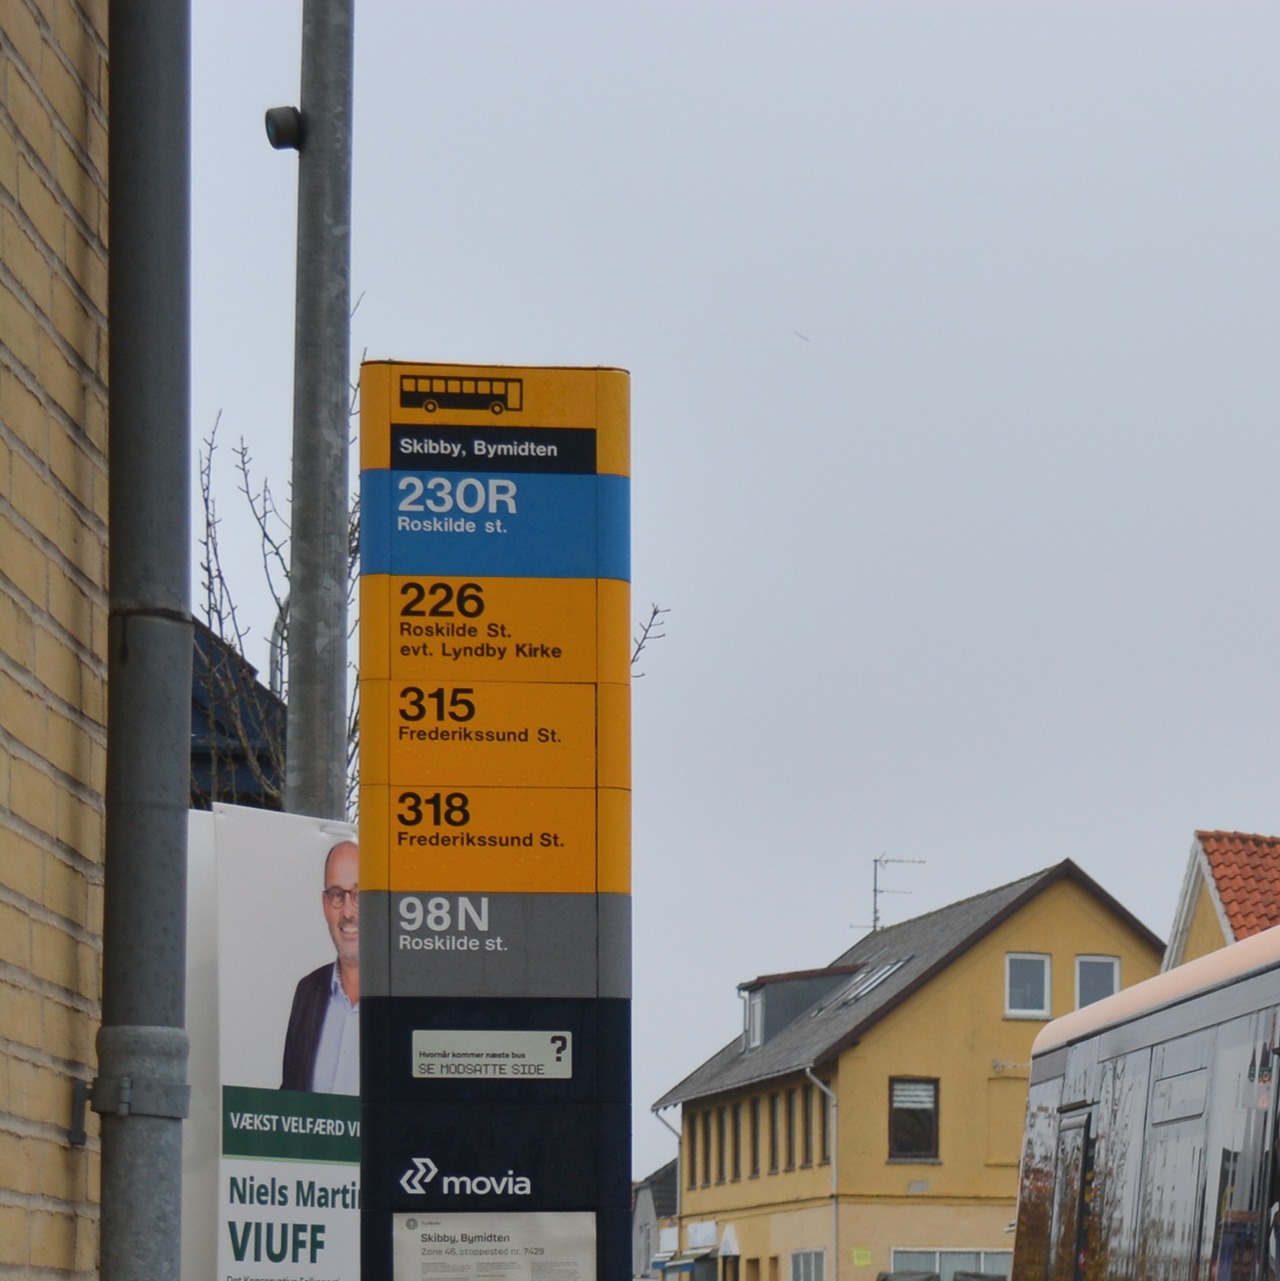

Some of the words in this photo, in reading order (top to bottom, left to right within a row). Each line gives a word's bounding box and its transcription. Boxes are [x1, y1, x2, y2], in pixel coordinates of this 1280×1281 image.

[400, 438, 466, 457] Skibby,
[474, 440, 558, 458] Bymidten
[398, 476, 517, 514] 230R
[397, 517, 476, 532] Roskilde
[485, 518, 507, 533] st.
[400, 582, 485, 618] 226
[400, 622, 478, 637] Roskilde
[487, 623, 512, 638] St.
[400, 643, 433, 657] evt.
[442, 643, 507, 661] Lyndby
[515, 643, 562, 659] Kirke
[399, 687, 475, 722] 315
[399, 726, 528, 742] Frederikssund
[537, 728, 561, 743] St.
[397, 792, 470, 827] 318
[397, 832, 533, 847] Frederikssund
[540, 833, 564, 848] St.
[399, 896, 489, 931] 98N
[399, 935, 479, 950] Roskilde
[485, 937, 508, 951] st.
[419, 1051, 450, 1059] Hvornår
[452, 1051, 483, 1059] kommer
[511, 1051, 525, 1059] bus
[419, 1063, 435, 1074] SE
[440, 1063, 507, 1075] MODSATTE
[511, 1064, 545, 1075] SIDE
[230, 1112, 279, 1130] VÆKST
[281, 1116, 345, 1136] VELFÆRD
[443, 1170, 531, 1195] movia
[229, 1176, 289, 1206] Niels
[296, 1180, 361, 1210] Marti
[228, 1221, 326, 1263] VIUFF
[421, 1233, 458, 1244] Skibby,
[461, 1233, 510, 1244] Bymidten
